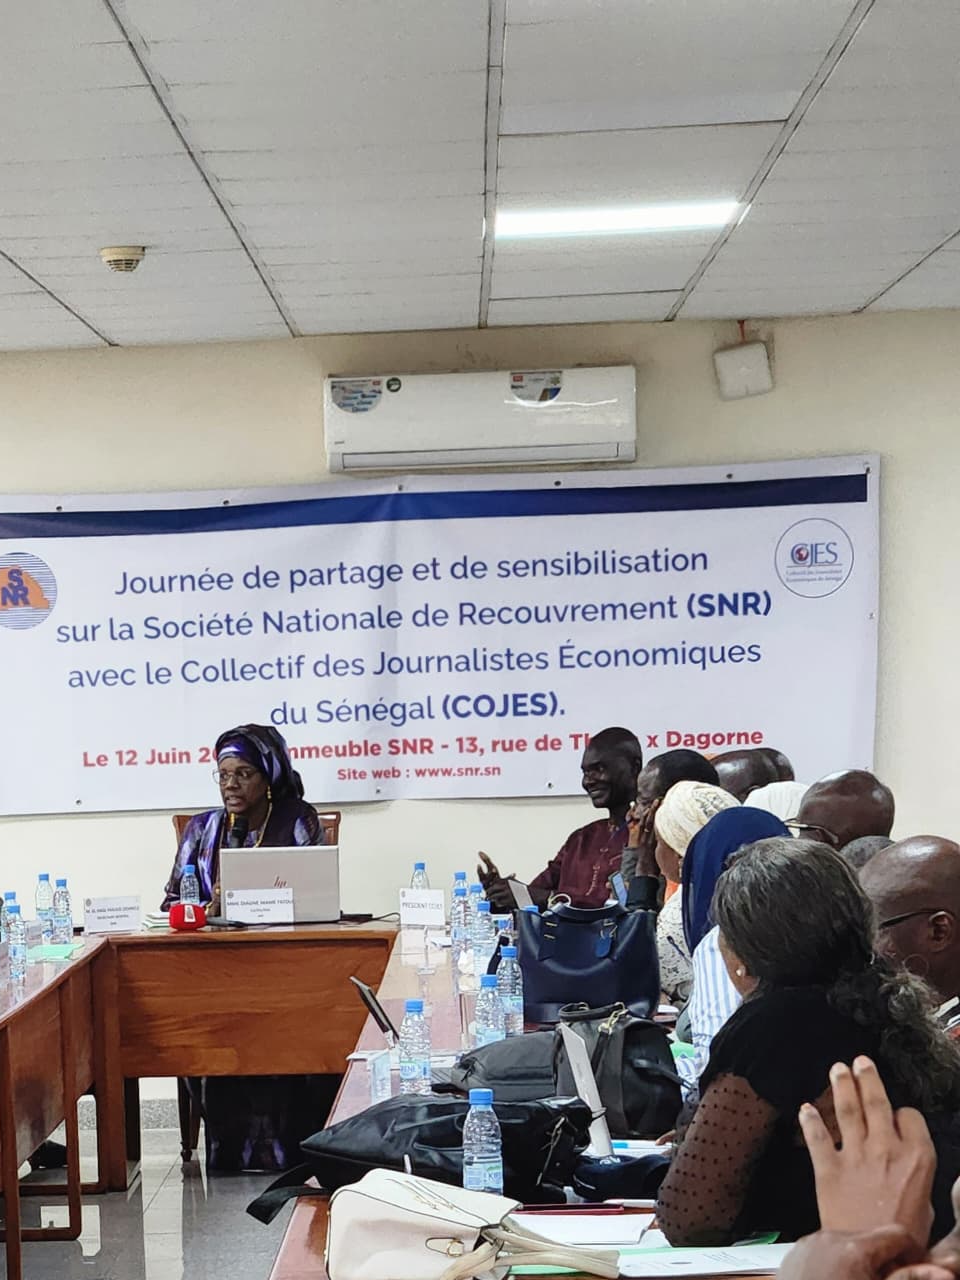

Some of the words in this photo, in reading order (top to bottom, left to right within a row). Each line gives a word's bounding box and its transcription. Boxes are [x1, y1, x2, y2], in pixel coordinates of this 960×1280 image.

[114, 567, 235, 596] Journée
[242, 564, 281, 590] de
[289, 562, 404, 594] partage
[411, 557, 442, 582] et
[449, 554, 489, 580] de
[496, 547, 708, 579] sensibilisation
[56, 624, 102, 644] sur
[108, 616, 135, 641] la
[143, 612, 254, 640] Société
[262, 605, 404, 635] Nationale
[411, 602, 450, 628] de
[458, 594, 679, 627] Recouvrement
[686, 589, 772, 620] (SNR)
[67, 668, 137, 689] avec
[145, 661, 173, 686] le
[180, 654, 306, 684] Collectif
[312, 653, 366, 678] des
[372, 647, 550, 676] Journalistes
[558, 638, 762, 672] Économiques
[269, 700, 308, 726] du
[316, 696, 436, 728] Sénégal
[441, 690, 566, 721] (COJES).
[82, 751, 109, 768] Le
[115, 749, 139, 767] 12
[145, 747, 192, 766] Juin
[387, 737, 435, 756] SNR
[455, 736, 485, 757] 13,
[491, 738, 528, 753] rue
[534, 733, 563, 752] de
[646, 734, 660, 748] x
[665, 730, 764, 750] Dagorne
[337, 768, 368, 781] Site
[371, 766, 402, 780] web
[414, 766, 502, 778] www.snr.sn
